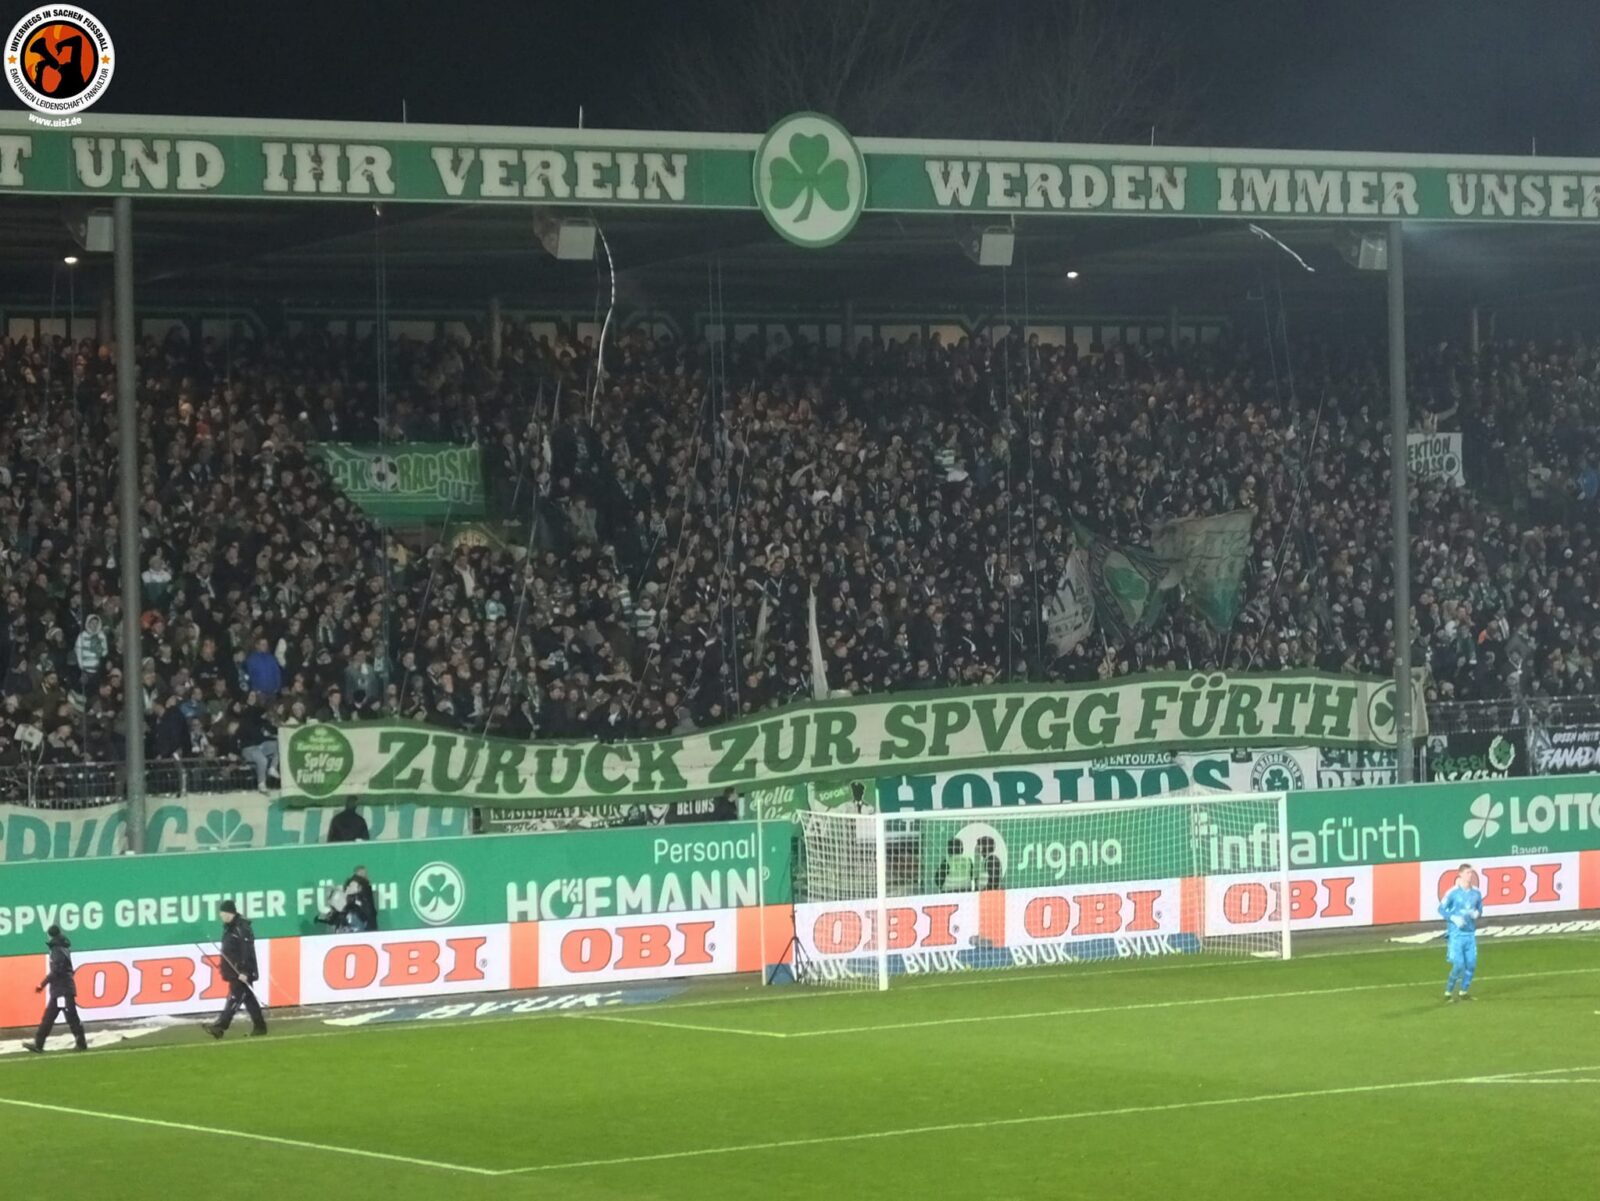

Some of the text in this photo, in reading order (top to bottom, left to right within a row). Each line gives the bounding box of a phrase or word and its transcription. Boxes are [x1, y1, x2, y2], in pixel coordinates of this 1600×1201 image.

[72, 137, 225, 191] UND
[262, 142, 395, 195] IHR
[431, 147, 687, 200] VEREIN
[925, 160, 1187, 210] WERDEN
[1217, 167, 1419, 215] IMMER
[398, 450, 480, 492] RACISM
[1408, 435, 1451, 461] EKTION
[437, 479, 475, 504] OUT
[708, 712, 861, 784] ZUR
[879, 692, 1121, 760] SPVGG
[1134, 675, 1357, 739] FÜRTH
[1110, 751, 1173, 766] ENTOURAG
[654, 833, 756, 865] Personal
[1018, 838, 1122, 880] signia
[0, 900, 103, 936] SPVGG
[506, 867, 757, 922] HOFMANN
[1023, 890, 1162, 938] OBI
[1223, 877, 1355, 924] OBI
[560, 921, 715, 973] OBI
[813, 904, 959, 955] OBI
[73, 957, 232, 1009] OBI
[322, 937, 487, 990] OBI
